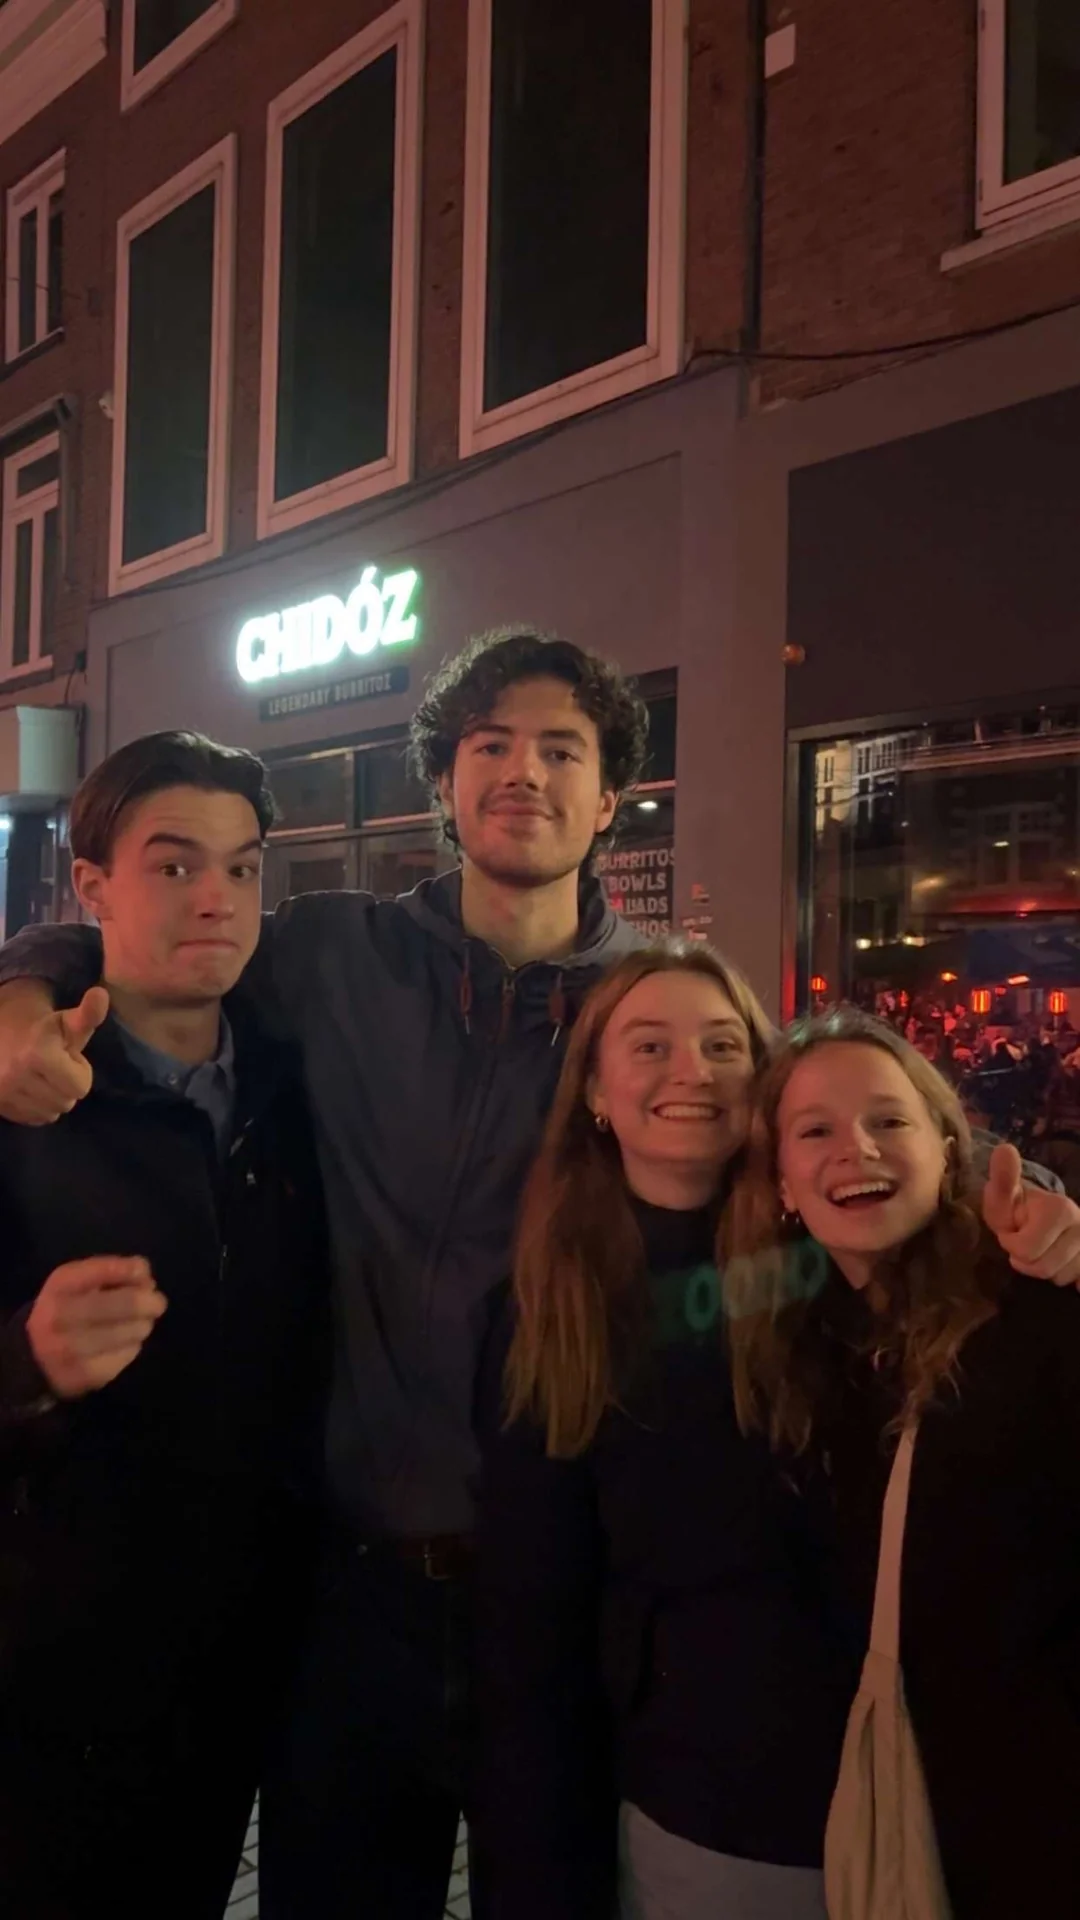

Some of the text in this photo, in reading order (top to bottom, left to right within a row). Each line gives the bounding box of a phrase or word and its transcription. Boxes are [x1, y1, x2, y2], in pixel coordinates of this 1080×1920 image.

[236, 564, 419, 682] CHIDÓZ
[268, 687, 330, 716] LEGENDARY
[608, 873, 667, 893] BOWLS
